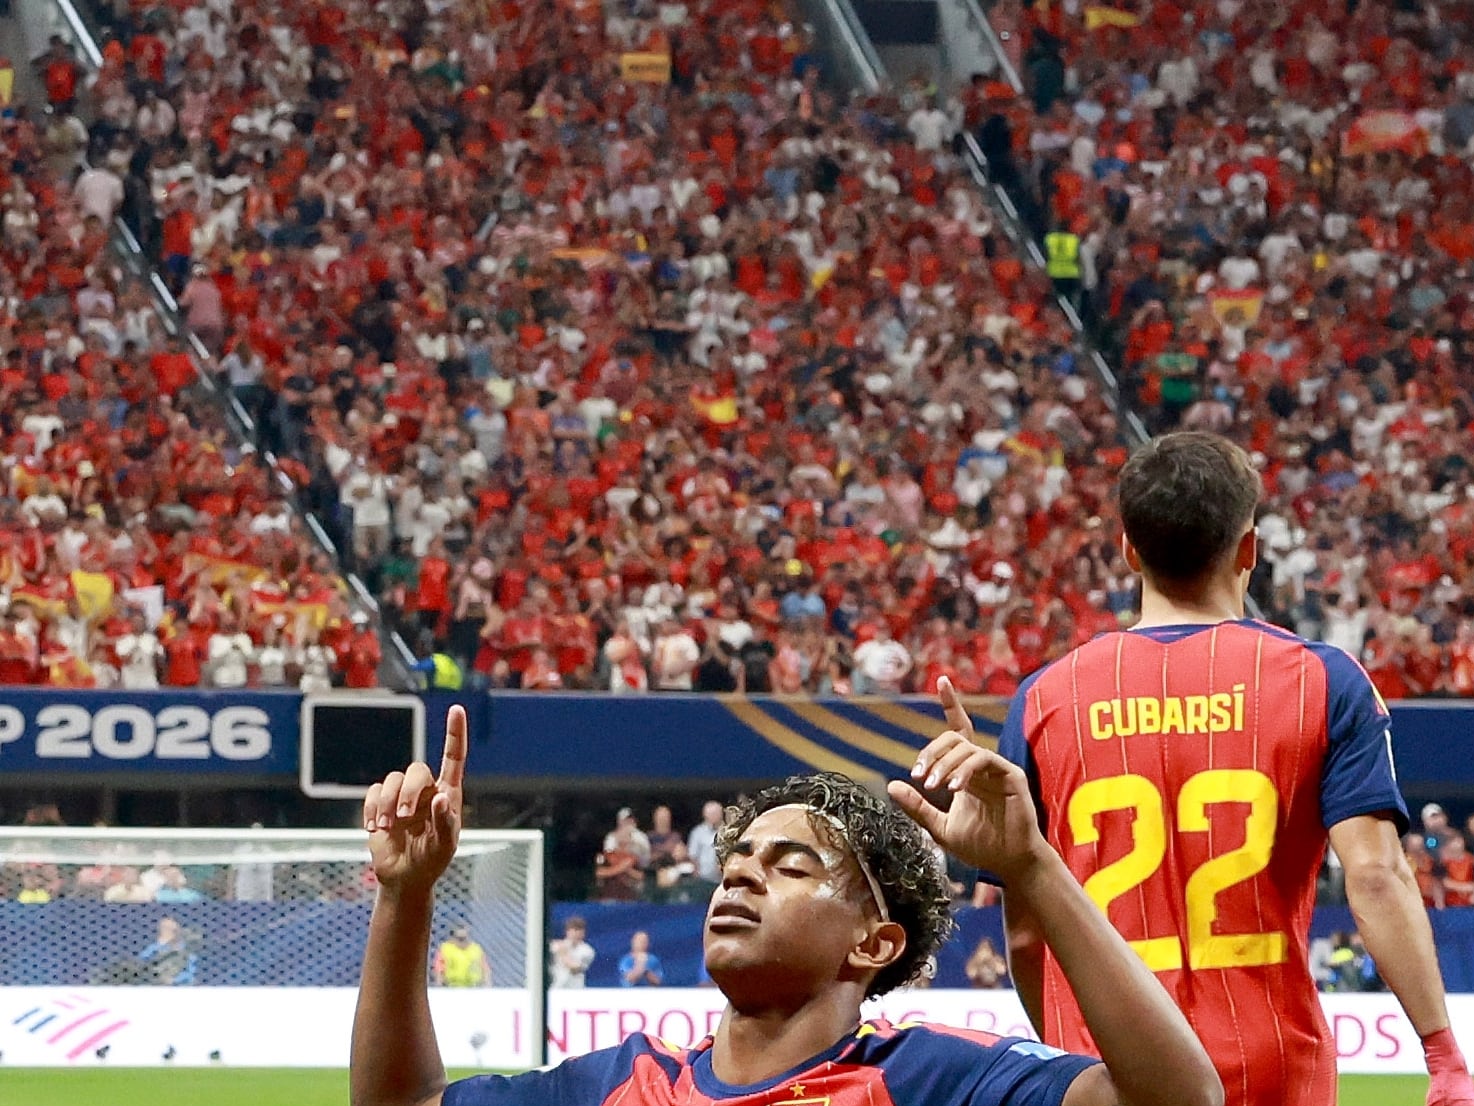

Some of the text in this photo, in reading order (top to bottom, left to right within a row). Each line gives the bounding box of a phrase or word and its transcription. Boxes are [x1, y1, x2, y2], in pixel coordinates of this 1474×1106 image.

[35, 704, 272, 760] 2026
[1089, 683, 1246, 740] CUBARSÍ
[1068, 769, 1288, 972] 22
